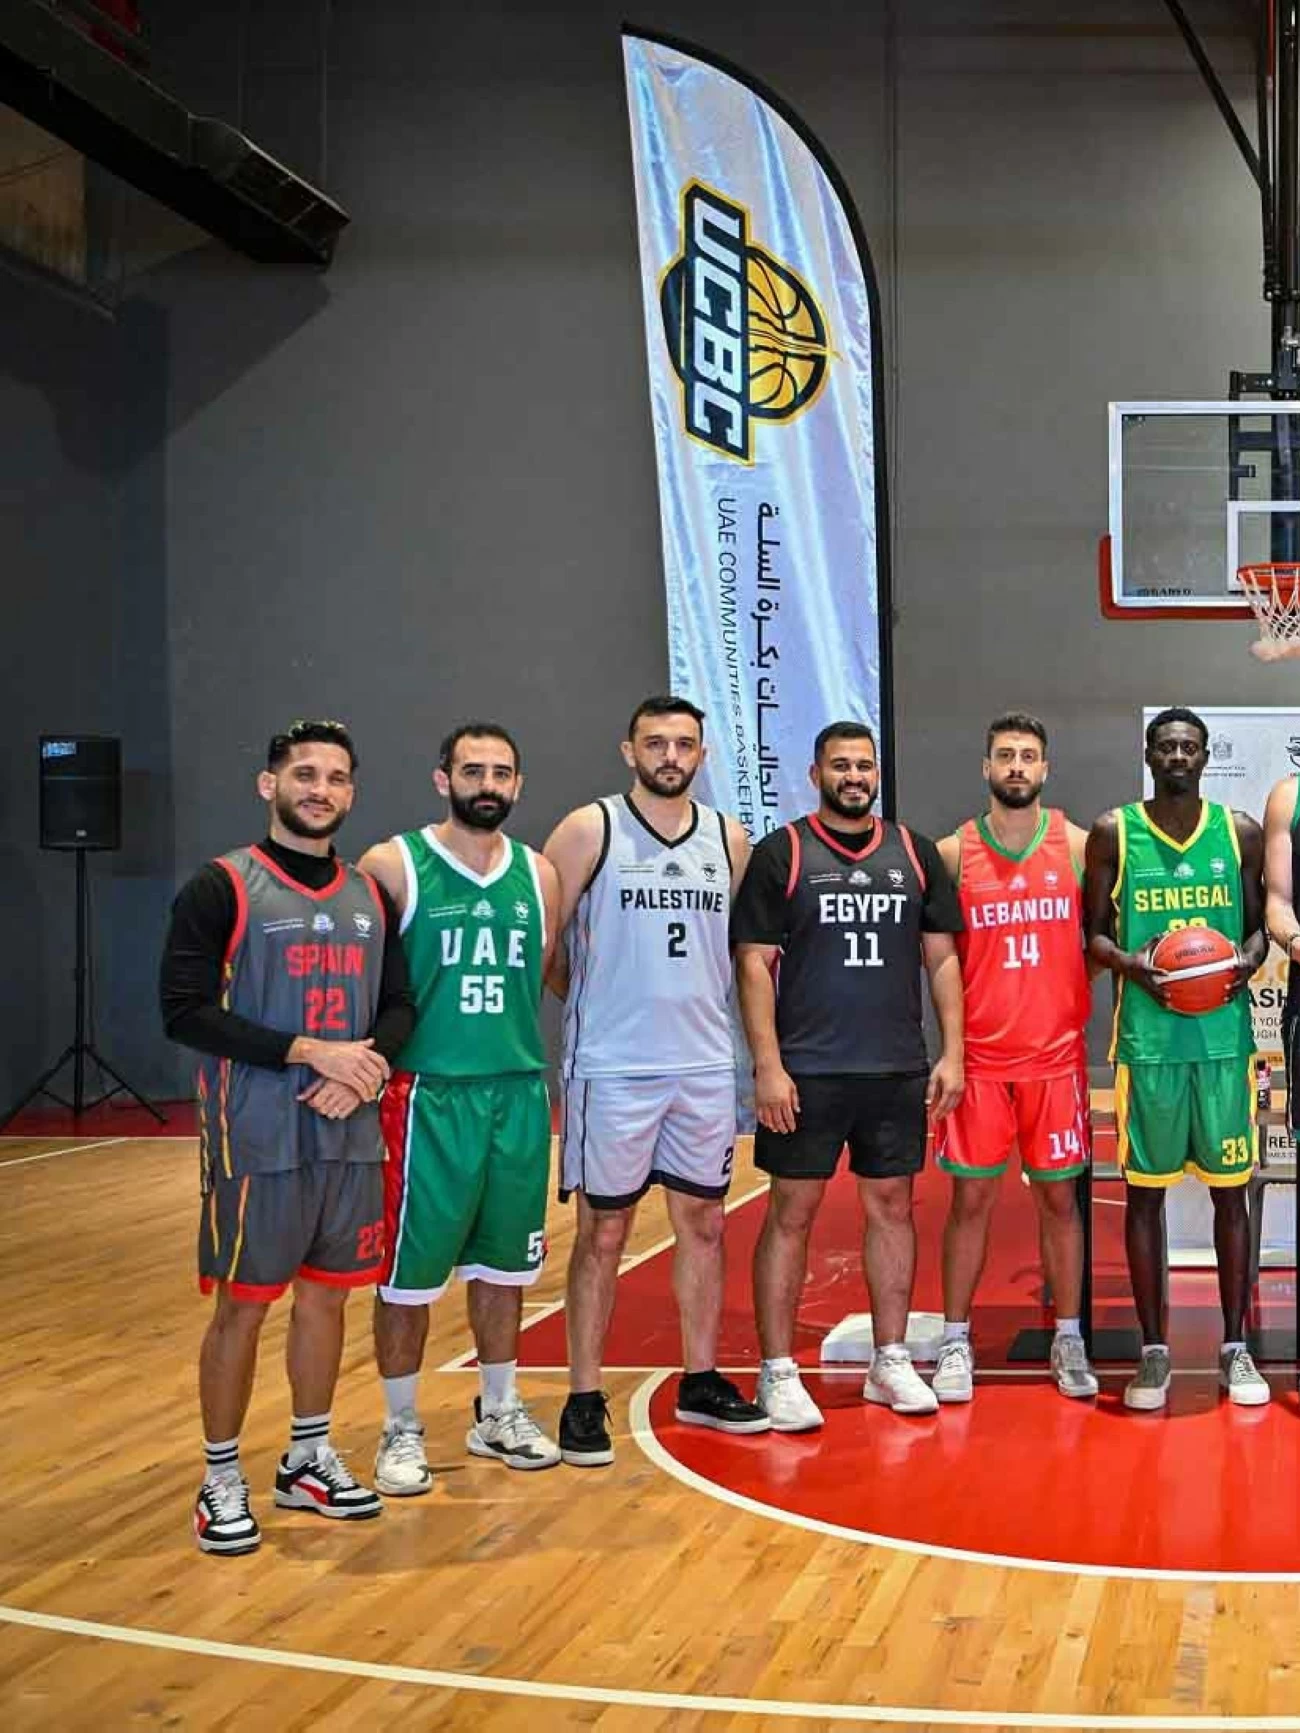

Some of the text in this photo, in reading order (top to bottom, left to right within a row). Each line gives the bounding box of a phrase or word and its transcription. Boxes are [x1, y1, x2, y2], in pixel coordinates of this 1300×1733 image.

[693, 198, 743, 450] UCBC
[717, 497, 737, 548] UAE
[620, 887, 724, 913] PALESTINE
[818, 893, 907, 924] EGYPT
[970, 895, 1071, 931] LEBANON
[1134, 884, 1233, 913] SENEGAL
[440, 927, 528, 968] UAE
[667, 922, 688, 958] 2
[843, 931, 885, 967] 11
[1002, 932, 1041, 970] 14
[284, 942, 365, 978] SPAIN
[304, 986, 349, 1032] 22
[459, 975, 505, 1014] 55
[721, 1146, 734, 1175] 2
[1049, 1128, 1080, 1160] 14
[1221, 1135, 1249, 1166] 33
